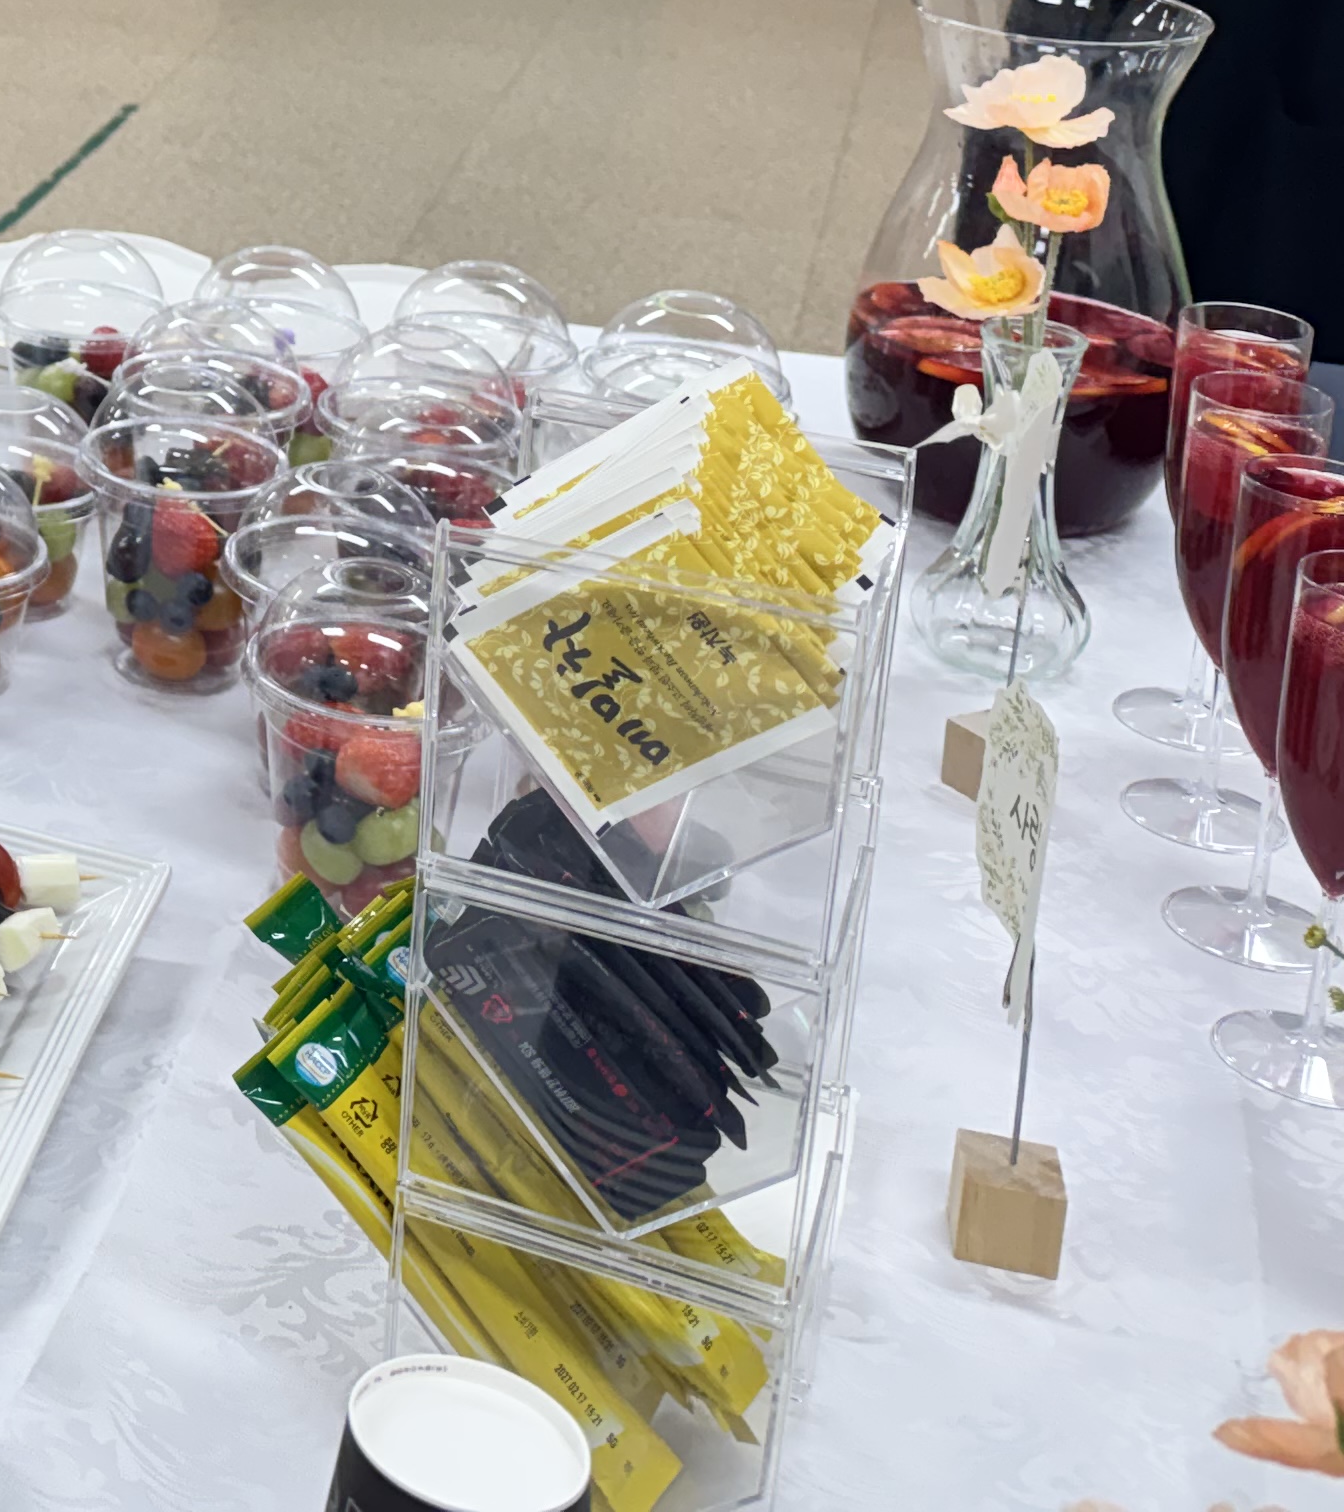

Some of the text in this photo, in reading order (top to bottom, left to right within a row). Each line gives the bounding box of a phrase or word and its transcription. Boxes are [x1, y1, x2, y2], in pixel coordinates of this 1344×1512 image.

[639, 619, 680, 668] Buckwheat
[687, 610, 736, 666] 녹차원
[543, 612, 670, 765] 메밀차
[307, 934, 323, 949] EASY
[306, 1051, 330, 1075] HACCP
[340, 1109, 364, 1137] OTHER
[713, 1242, 735, 1265] 15:21
[681, 1303, 701, 1328] 15:21
[553, 1362, 587, 1404] 2027.02.17
[583, 1403, 603, 1426] 15:21
